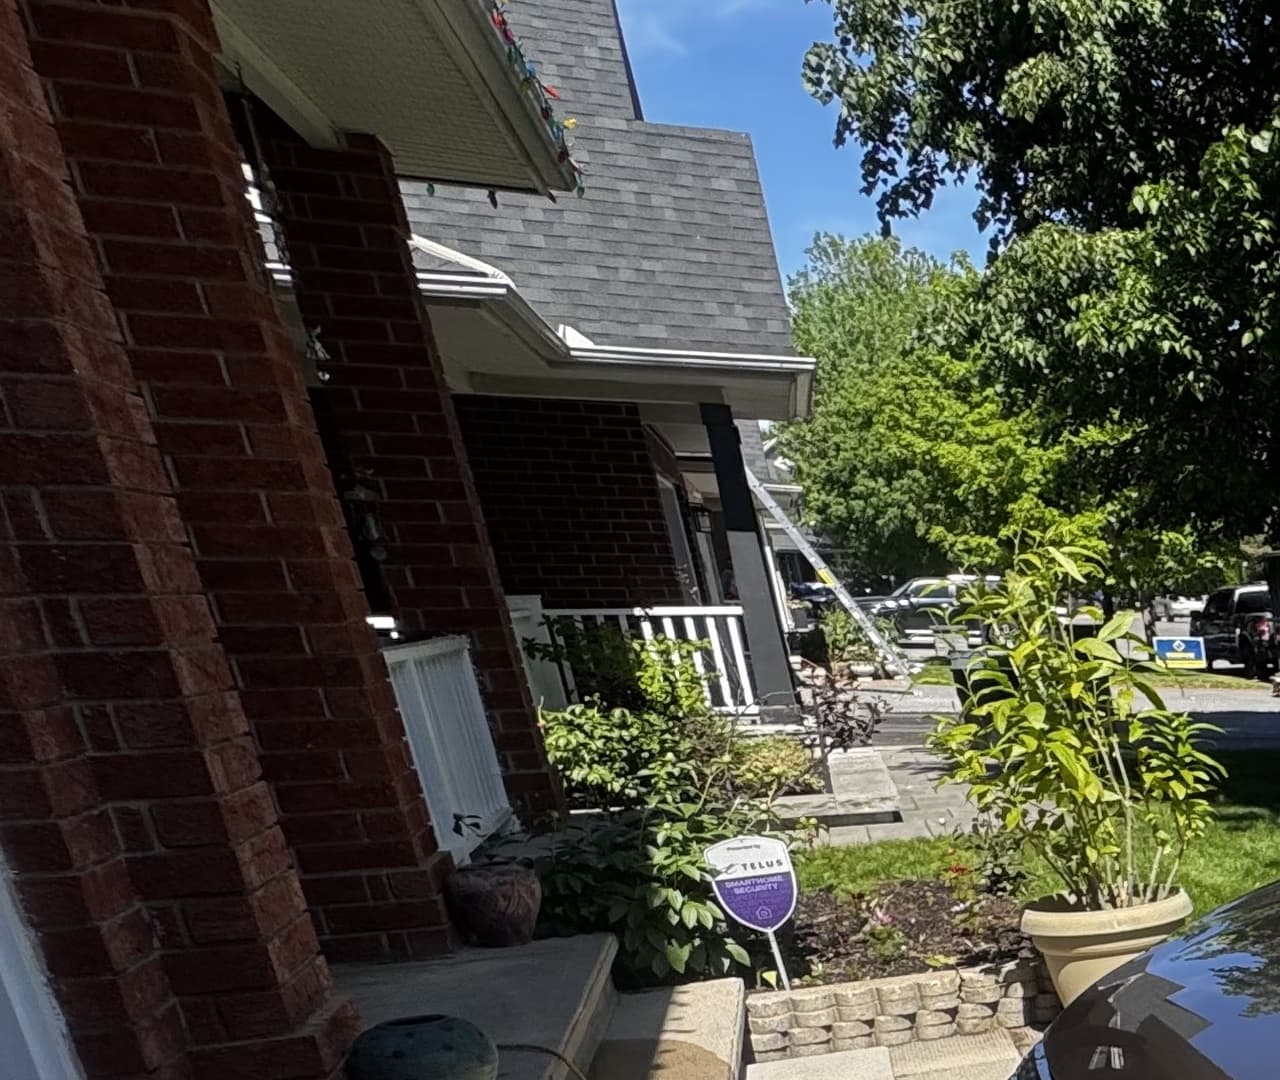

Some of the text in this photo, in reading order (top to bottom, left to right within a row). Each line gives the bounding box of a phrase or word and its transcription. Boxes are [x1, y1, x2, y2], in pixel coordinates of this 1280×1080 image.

[741, 859, 783, 871] TELUS
[725, 875, 783, 888] SMARTHOME
[734, 883, 778, 894] SECURITY
